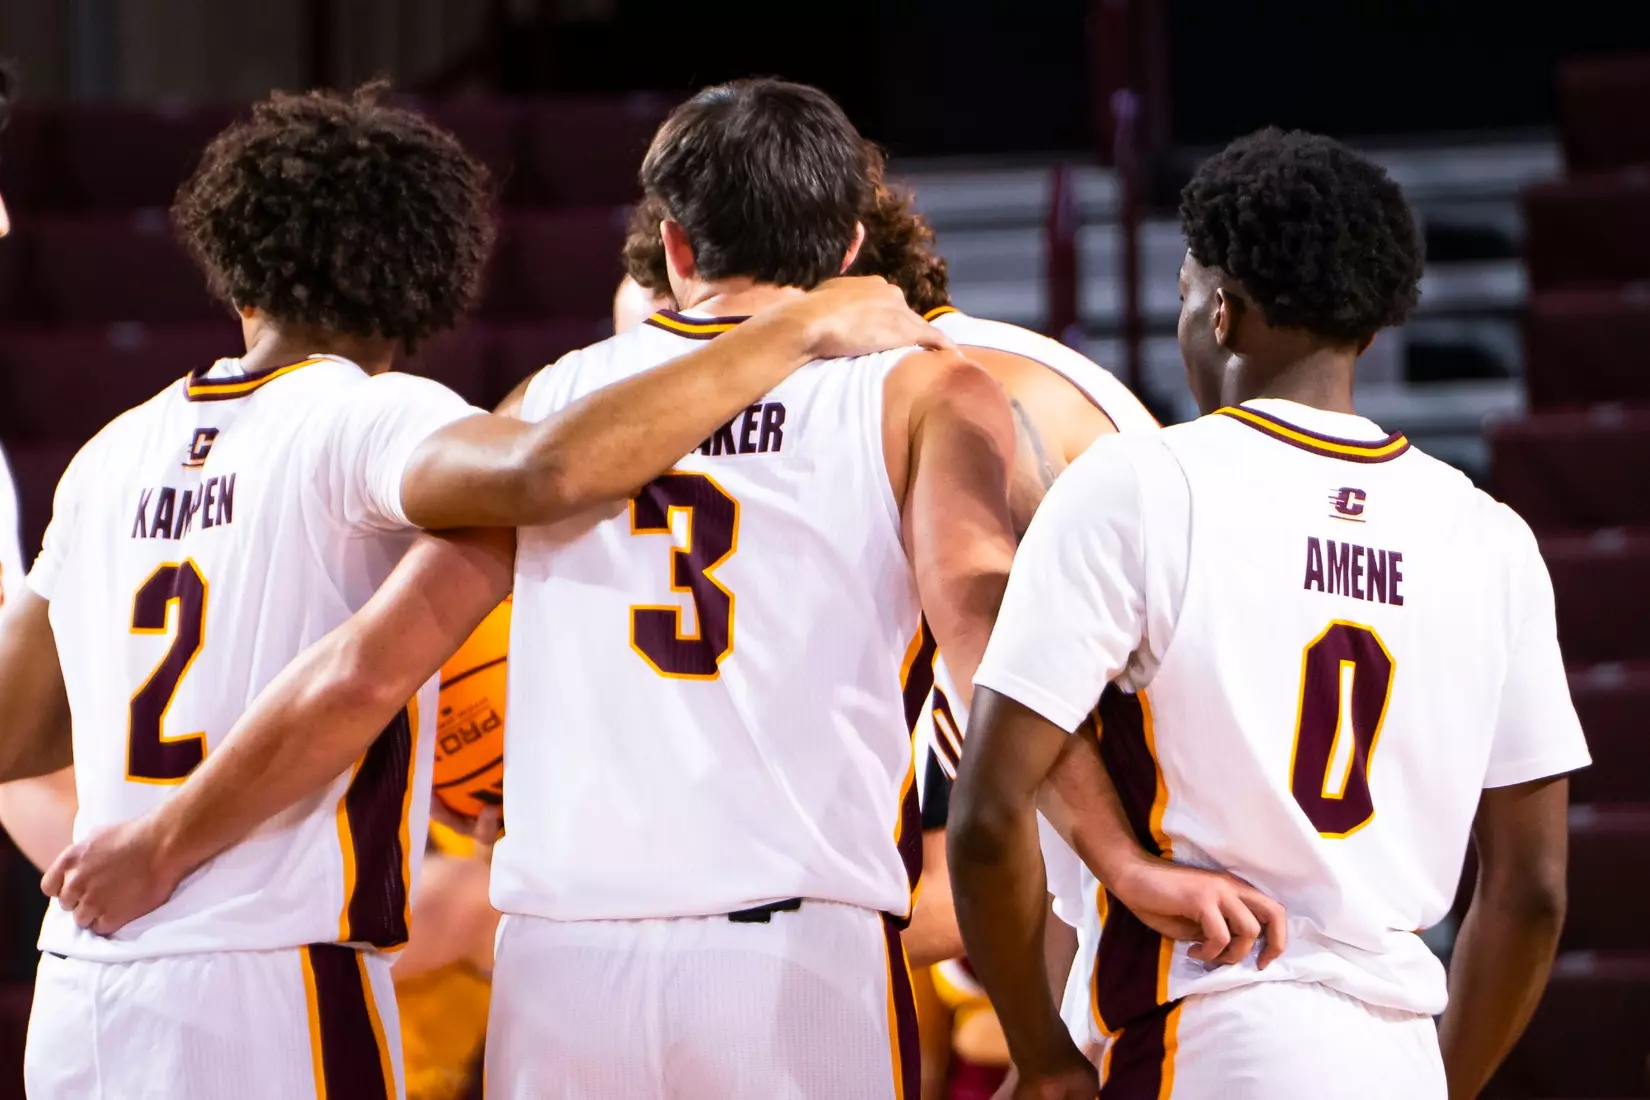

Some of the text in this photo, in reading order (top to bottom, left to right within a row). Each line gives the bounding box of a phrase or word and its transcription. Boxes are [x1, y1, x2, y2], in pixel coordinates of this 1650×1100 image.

[690, 402, 787, 456] KER
[124, 556, 210, 785] 2
[628, 471, 740, 680] 3
[1303, 536, 1404, 606] AMENE
[1288, 618, 1397, 840] 0
